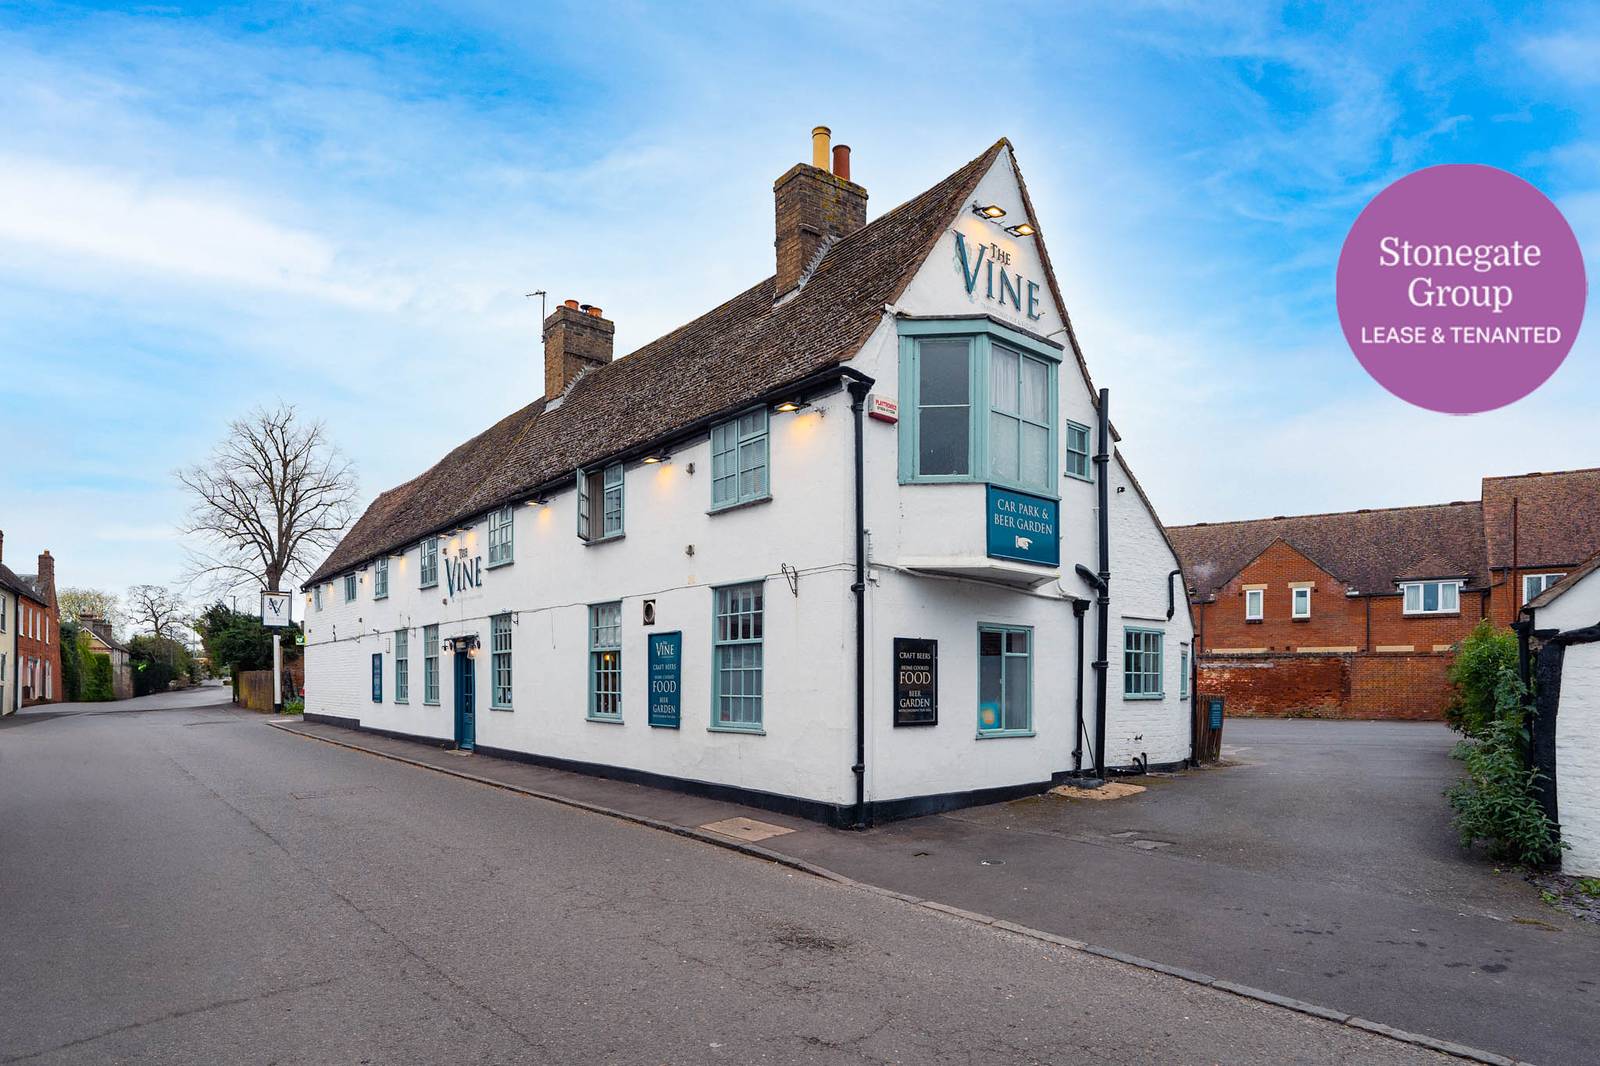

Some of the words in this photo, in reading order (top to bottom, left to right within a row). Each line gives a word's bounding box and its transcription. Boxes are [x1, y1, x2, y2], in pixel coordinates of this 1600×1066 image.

[990, 242, 1011, 266] THE
[952, 229, 1041, 321] VINE
[997, 499, 1016, 513] CAR
[1018, 503, 1039, 518] PARK
[1042, 508, 1049, 520] &
[994, 513, 1015, 528] BEER
[1017, 519, 1053, 535] GARDEN
[444, 555, 483, 597] VINE
[655, 642, 675, 657] VINE
[916, 652, 931, 660] BEERS
[899, 671, 931, 685] FOOD
[652, 680, 677, 693] FOOD
[652, 704, 676, 713] GARDEN
[899, 698, 930, 708] GARDEN
